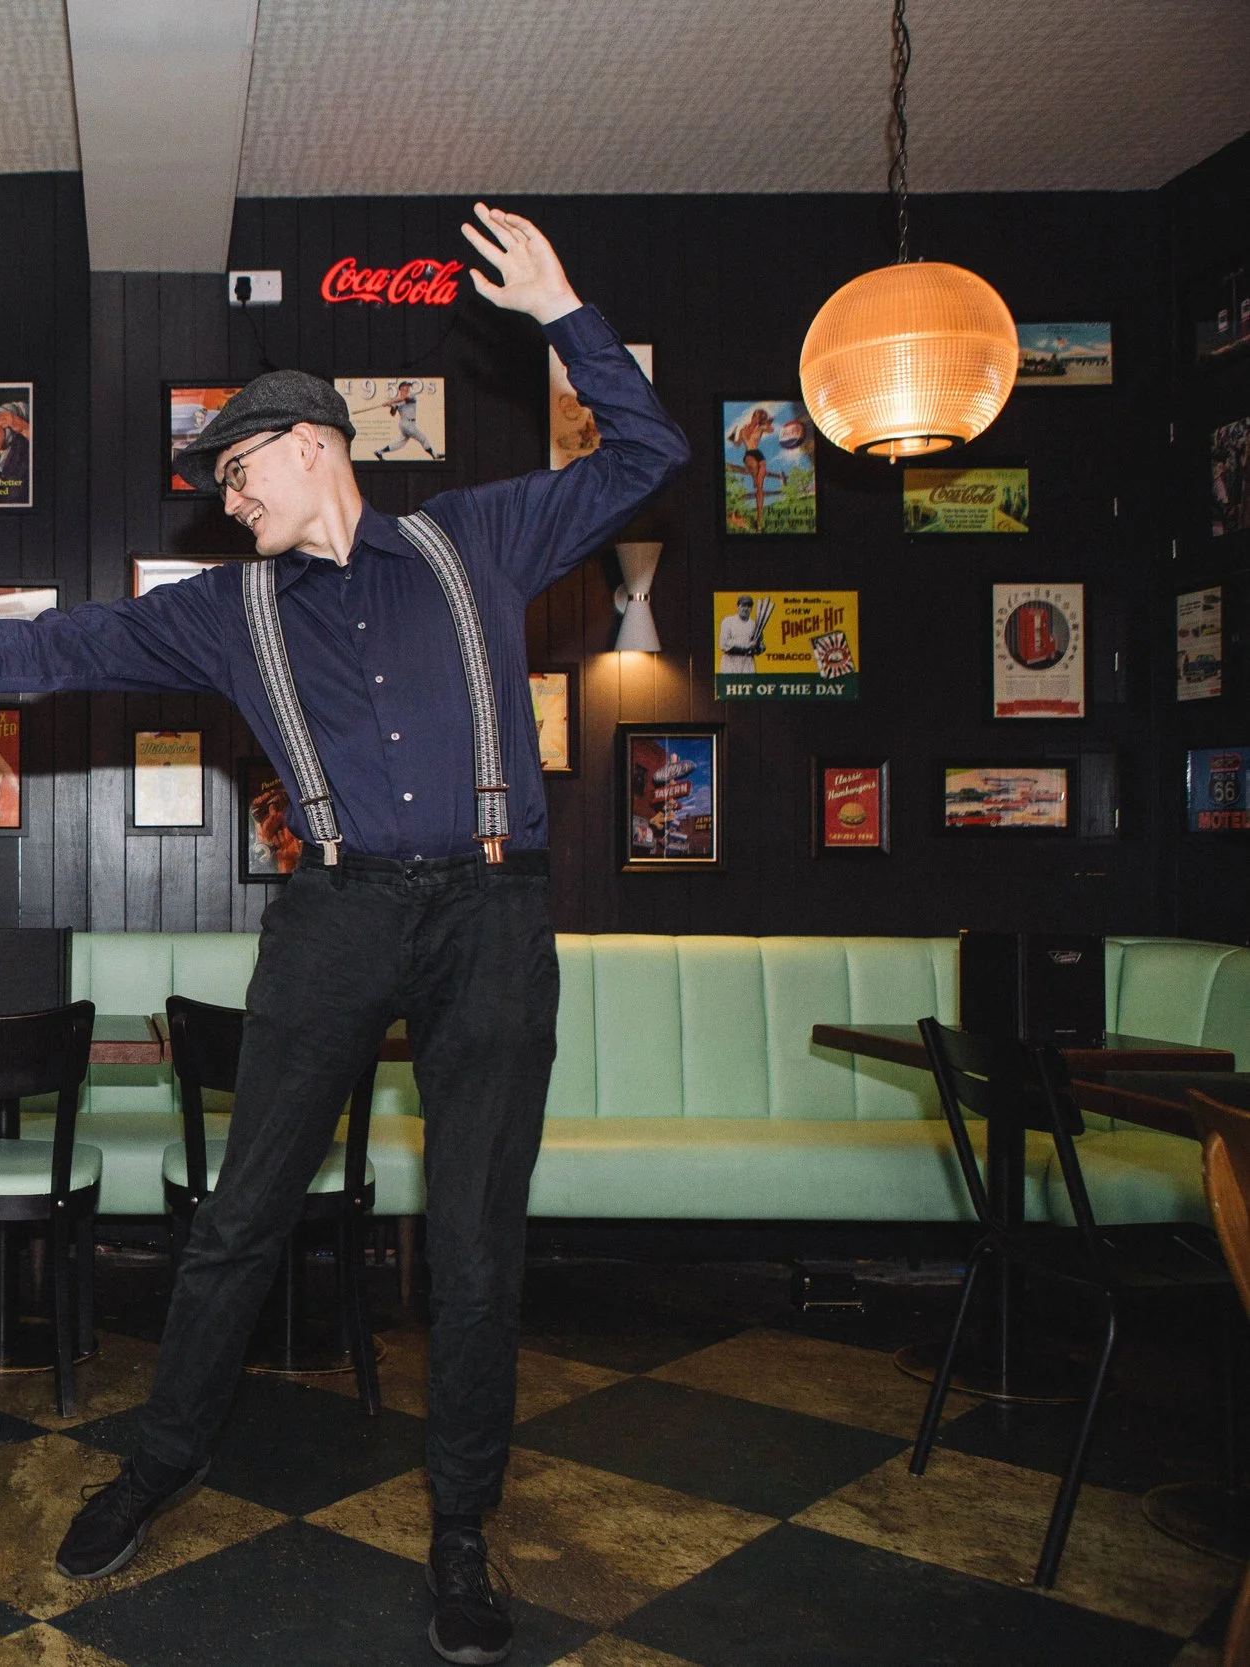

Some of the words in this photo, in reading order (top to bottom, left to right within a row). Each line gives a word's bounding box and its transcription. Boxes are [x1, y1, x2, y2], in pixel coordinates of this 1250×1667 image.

[321, 257, 464, 304] Coca-Cola
[781, 607, 844, 645] PINCH-HIT
[766, 653, 812, 661] TOBACCO
[726, 684, 753, 696] HIT
[756, 684, 776, 696] OF
[780, 684, 811, 696] THE
[816, 684, 846, 696] DAY
[834, 771, 863, 786] Classic
[654, 783, 689, 798] TAVERN
[828, 781, 877, 800] Hamburgers
